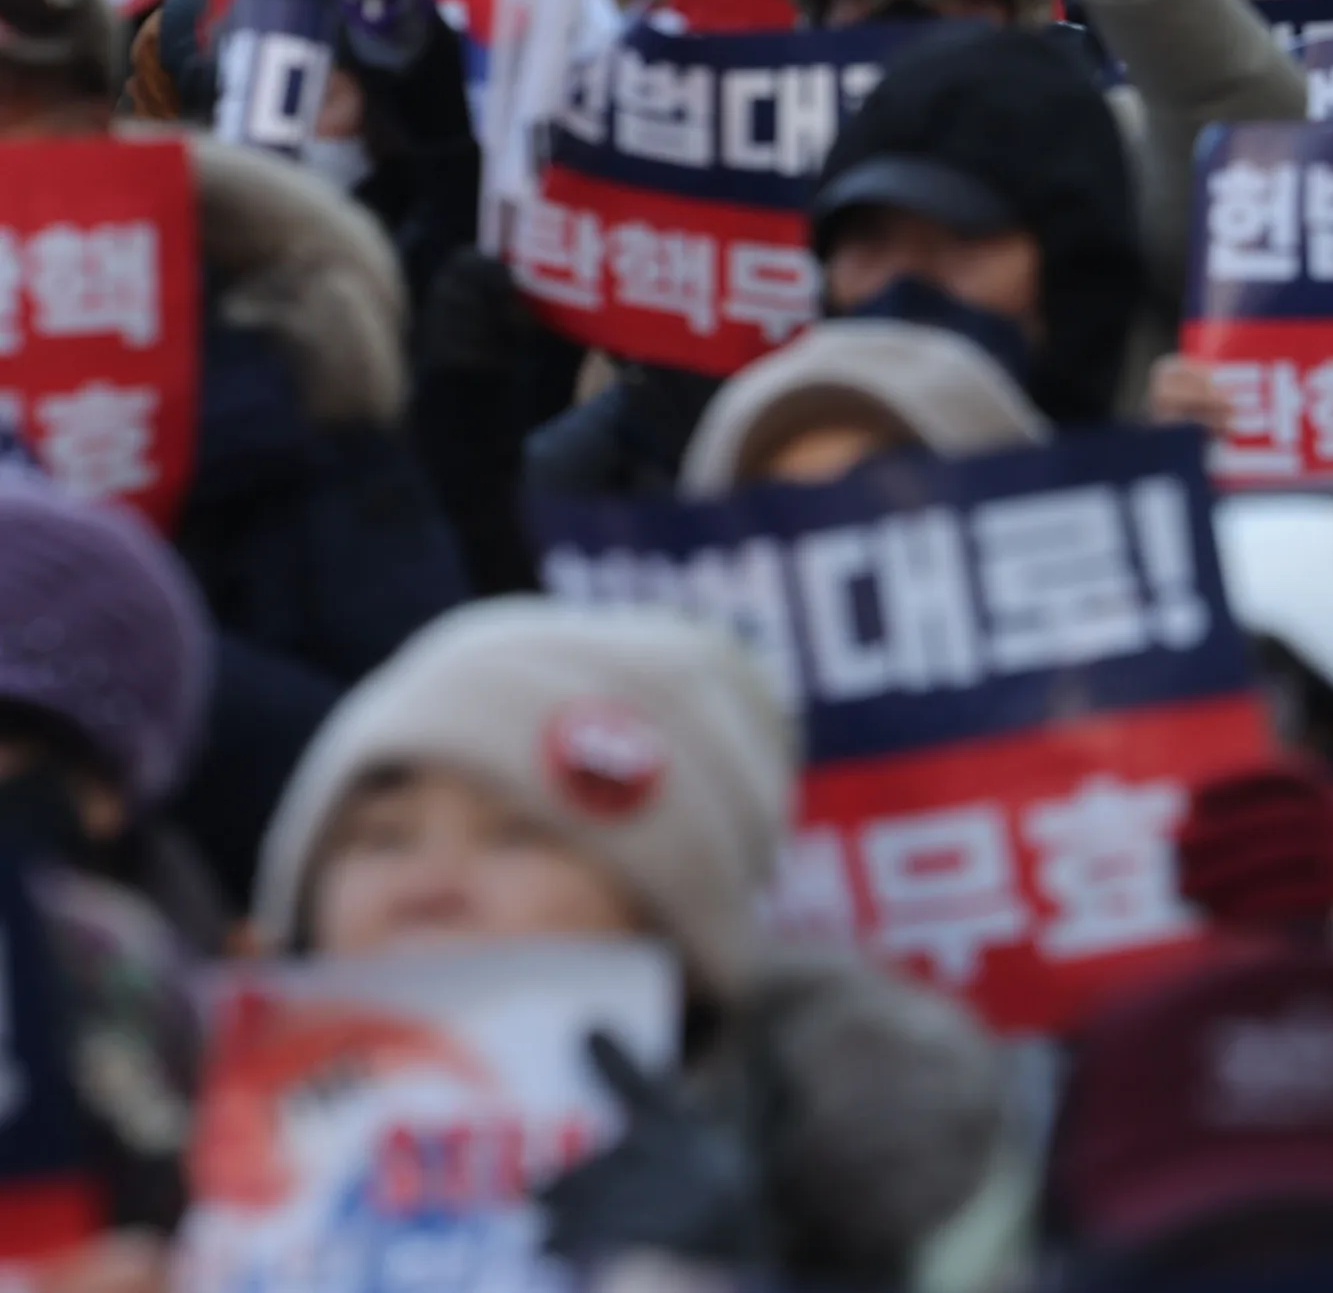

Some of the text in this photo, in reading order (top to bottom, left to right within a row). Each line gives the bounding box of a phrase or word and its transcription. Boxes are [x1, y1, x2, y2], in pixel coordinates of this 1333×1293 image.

[552, 51, 884, 178] 법대
[0, 380, 162, 499] 효
[545, 474, 1211, 707] 대로!
